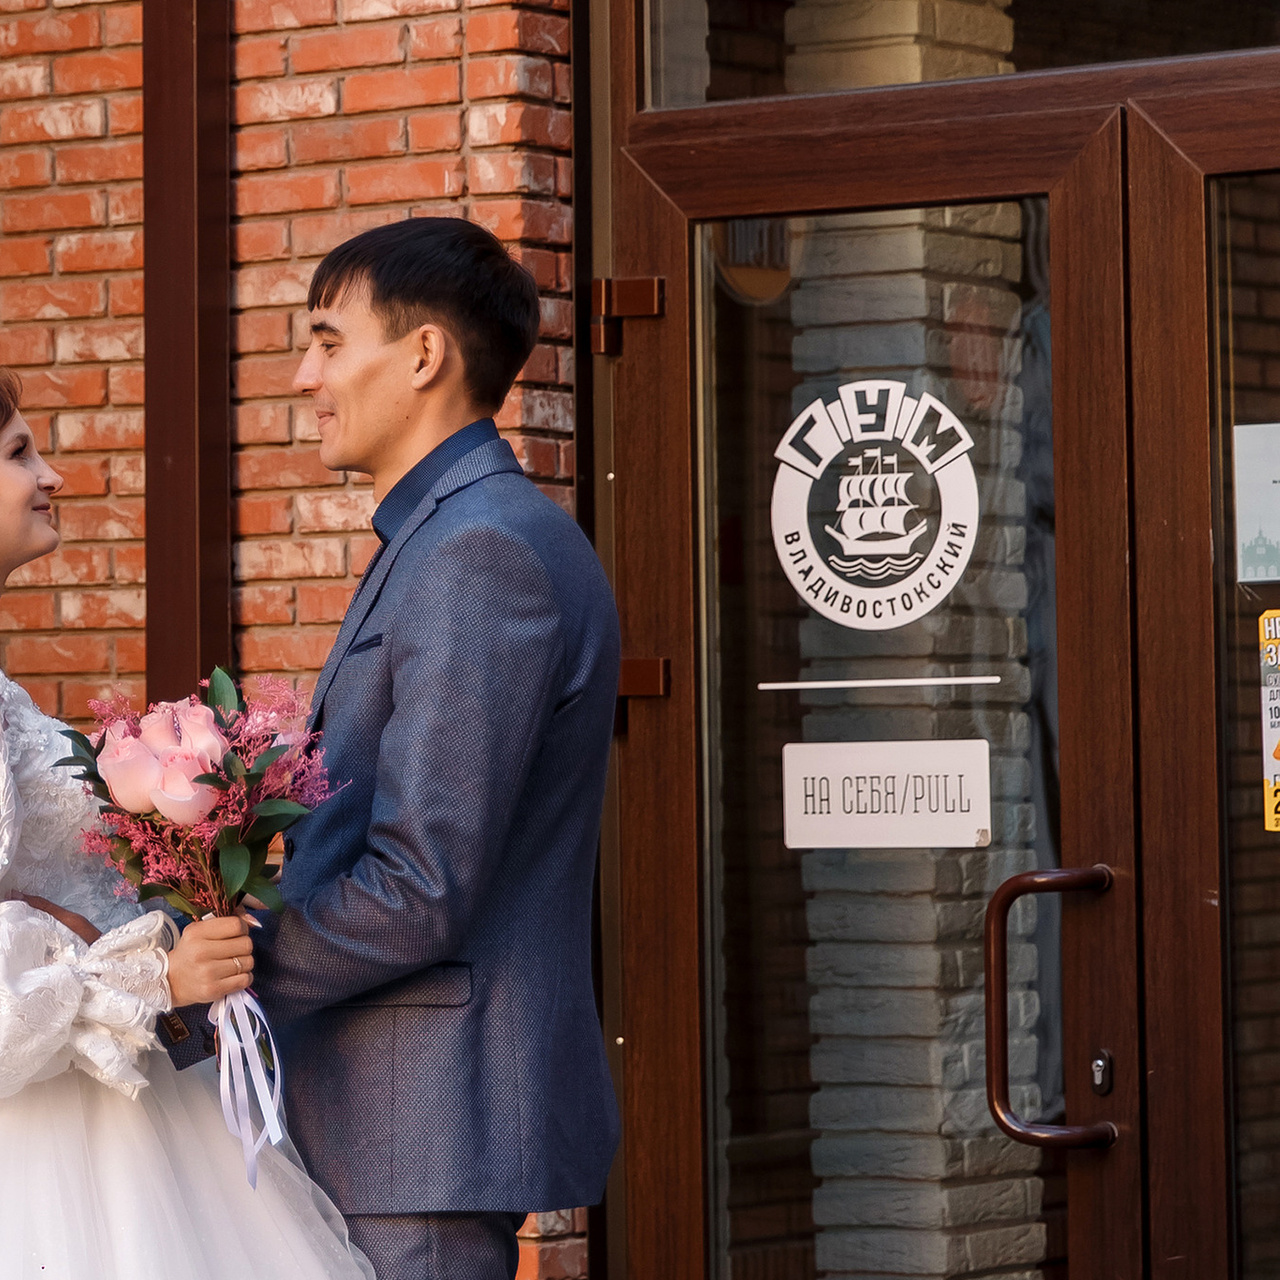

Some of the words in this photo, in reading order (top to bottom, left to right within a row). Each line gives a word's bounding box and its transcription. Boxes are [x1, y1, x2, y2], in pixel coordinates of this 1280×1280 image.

[789, 388, 963, 468] ГУМ
[784, 522, 968, 619] ВЛАДИВОСТОКСКИЙ
[803, 776, 831, 815] НА
